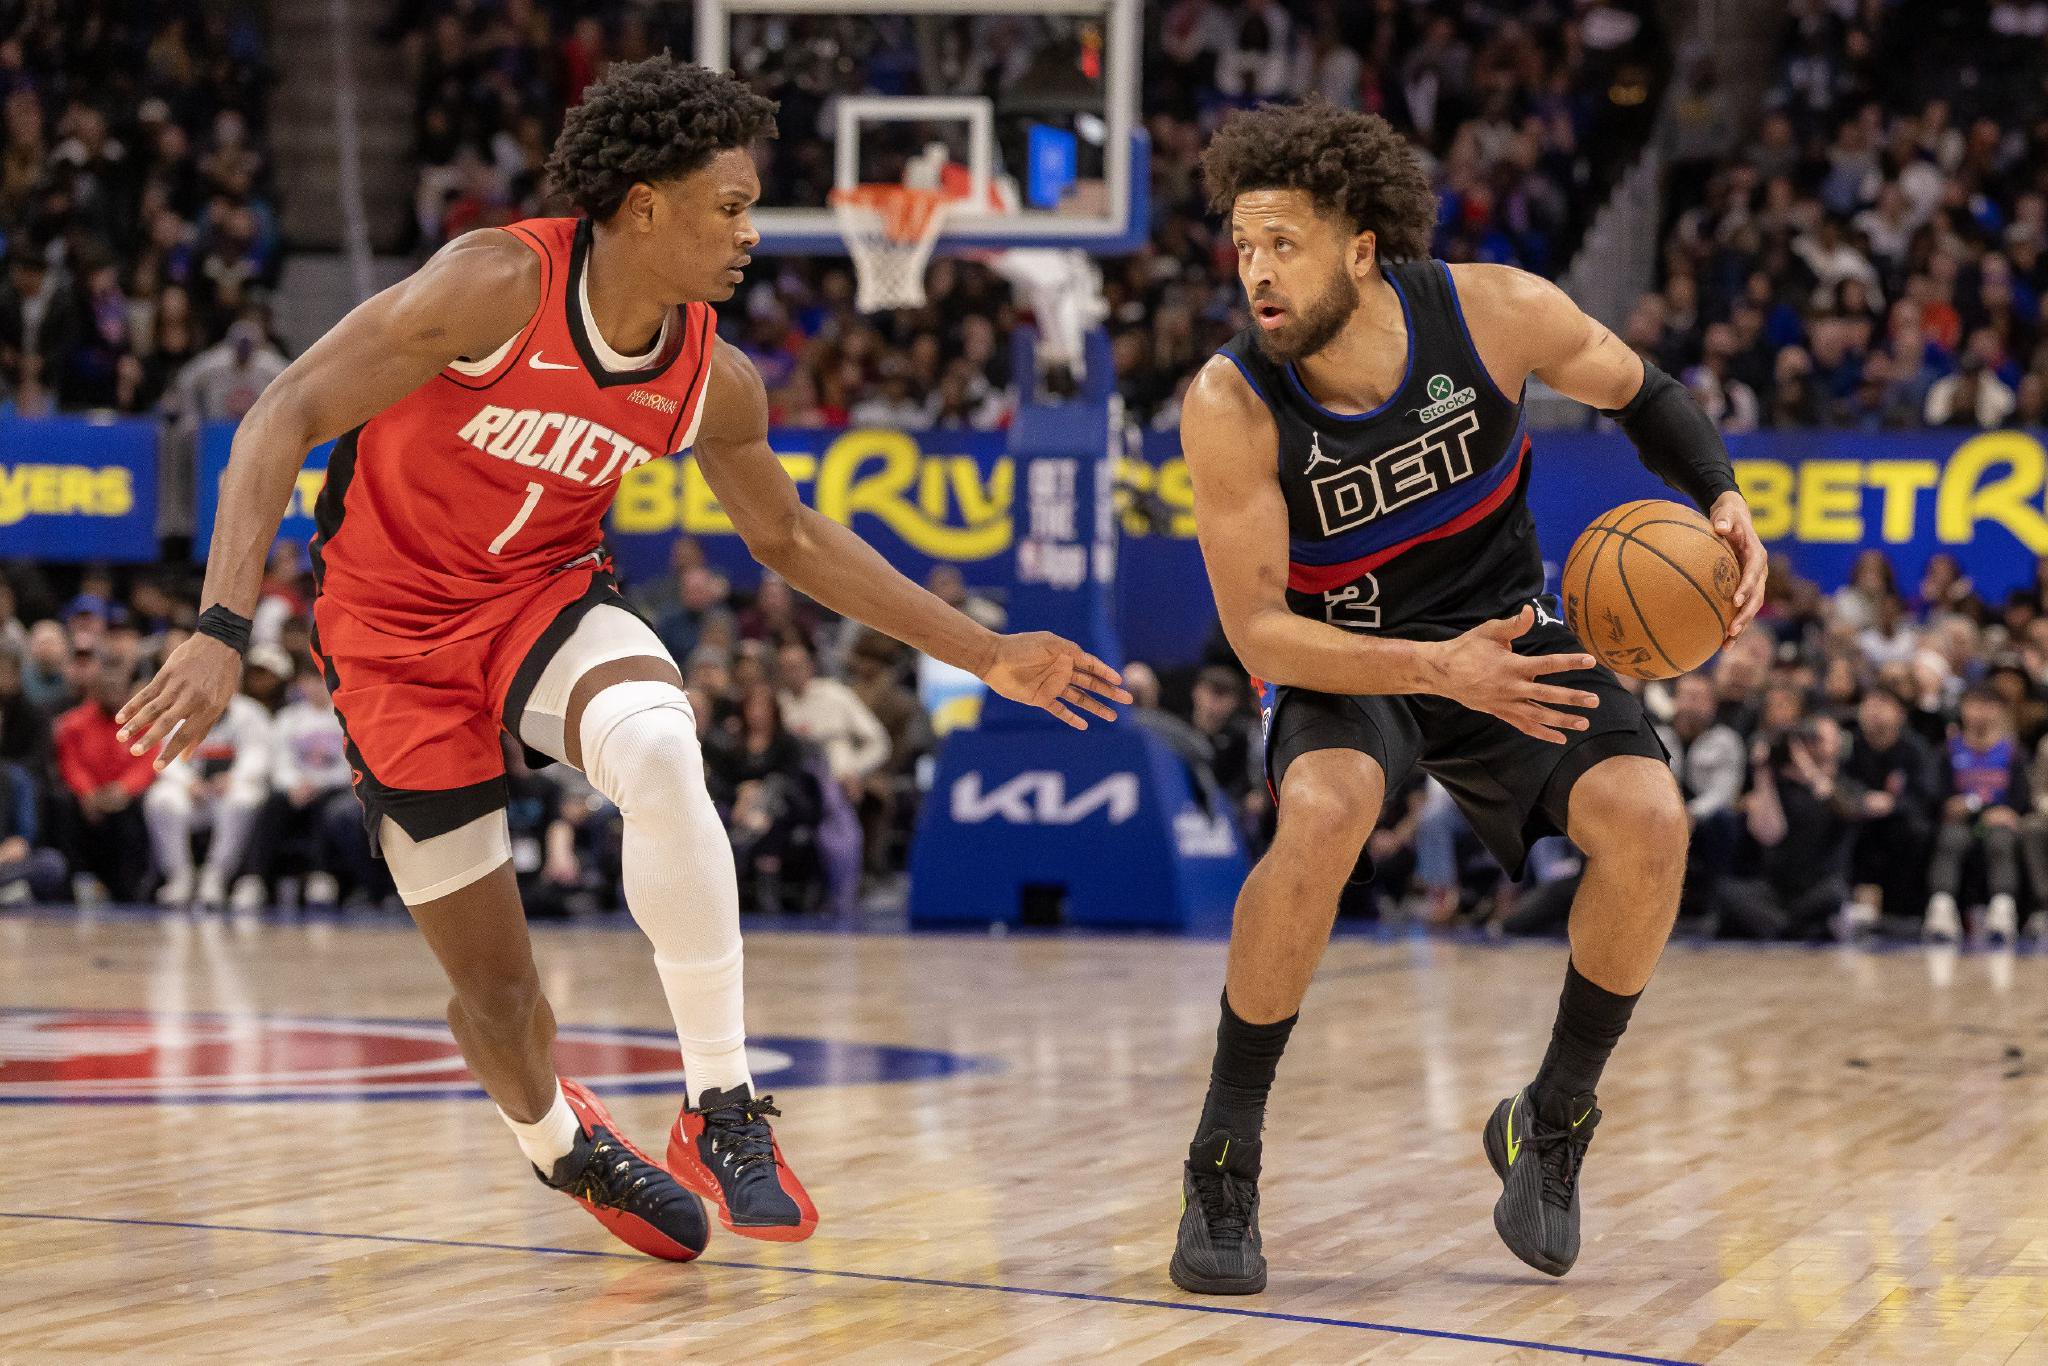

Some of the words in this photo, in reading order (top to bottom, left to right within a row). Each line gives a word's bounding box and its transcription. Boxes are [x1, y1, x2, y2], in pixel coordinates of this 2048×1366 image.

[1421, 389, 1475, 421] StockX
[1310, 410, 1480, 537] DET
[487, 481, 545, 555] 1
[1323, 571, 1381, 628] 2
